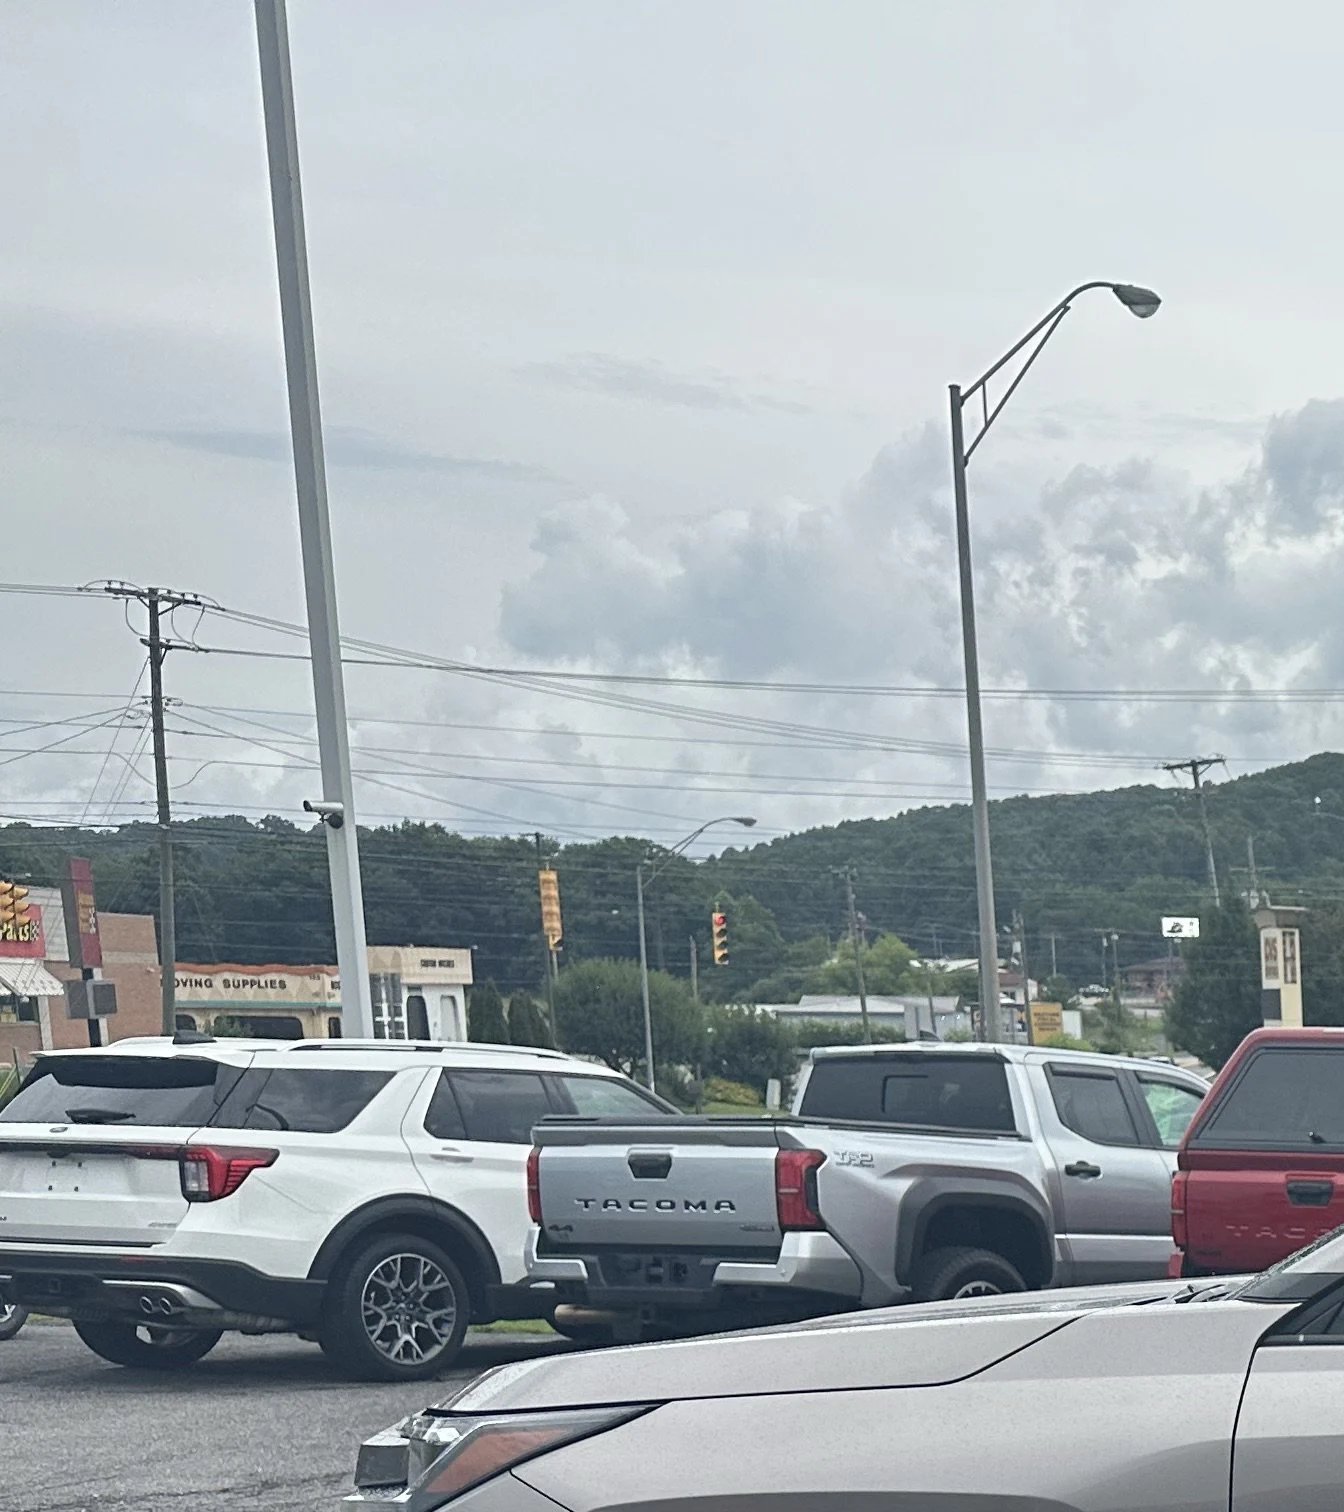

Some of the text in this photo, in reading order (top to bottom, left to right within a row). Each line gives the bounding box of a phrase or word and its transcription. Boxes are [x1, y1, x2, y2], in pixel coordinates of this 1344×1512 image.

[160, 978, 287, 990] OVING SUPPLIES
[575, 1198, 737, 1214] TACOMA
